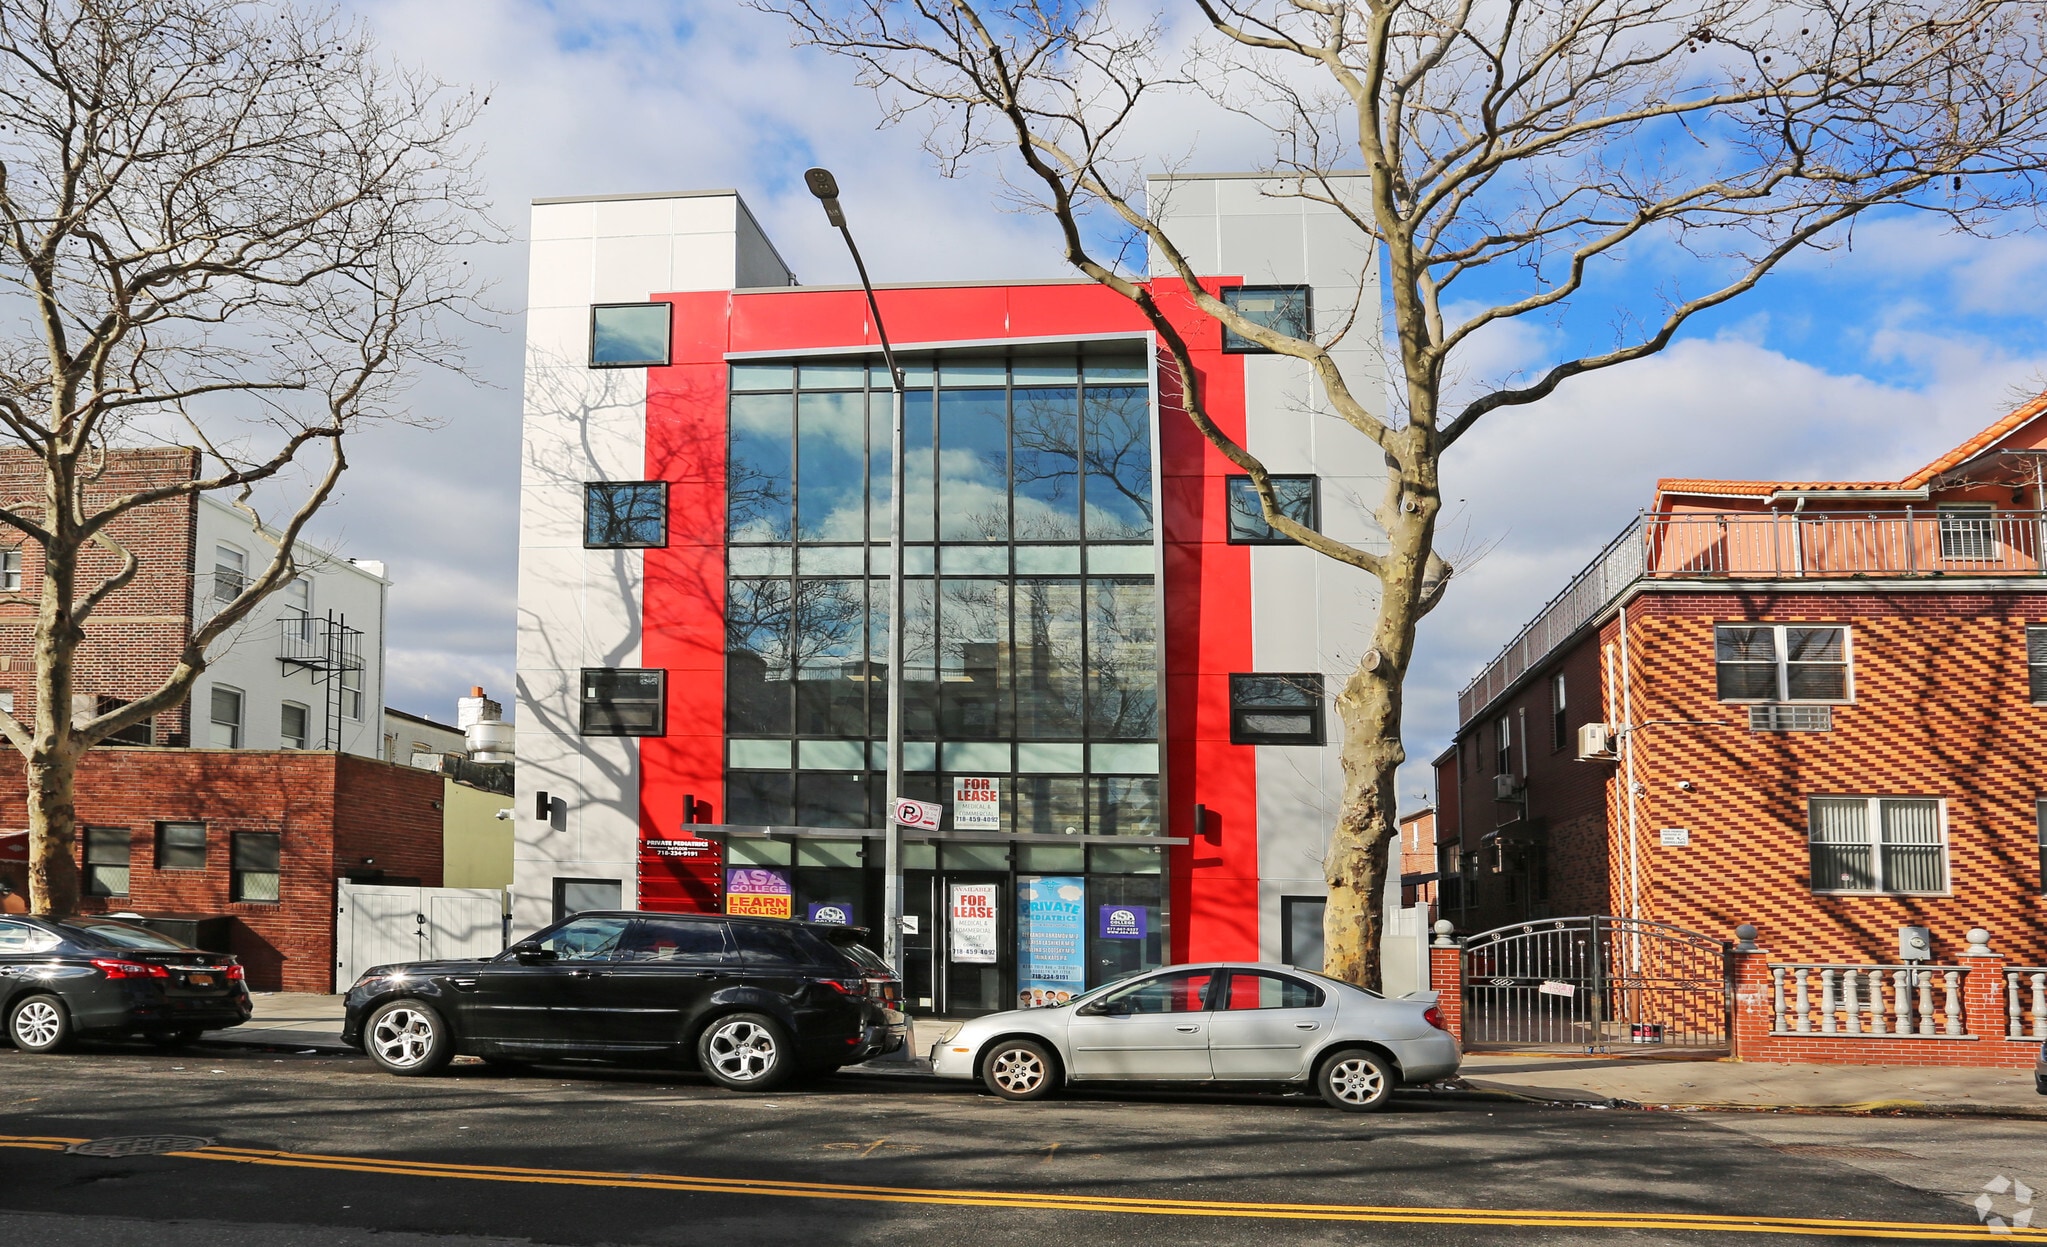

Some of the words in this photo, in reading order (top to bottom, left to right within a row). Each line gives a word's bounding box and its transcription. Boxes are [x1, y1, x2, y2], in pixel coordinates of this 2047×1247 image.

[964, 778, 990, 790] FOR
[958, 791, 996, 801] LEASE
[731, 870, 786, 885] ASA
[730, 885, 787, 893] COLLEGE
[729, 897, 788, 907] LEARN
[960, 895, 986, 906] FOR
[730, 907, 787, 915] ENGLISH
[953, 907, 994, 918] LEASE
[1021, 902, 1080, 915] PRIVATE
[953, 948, 995, 956] 718-459-4092
